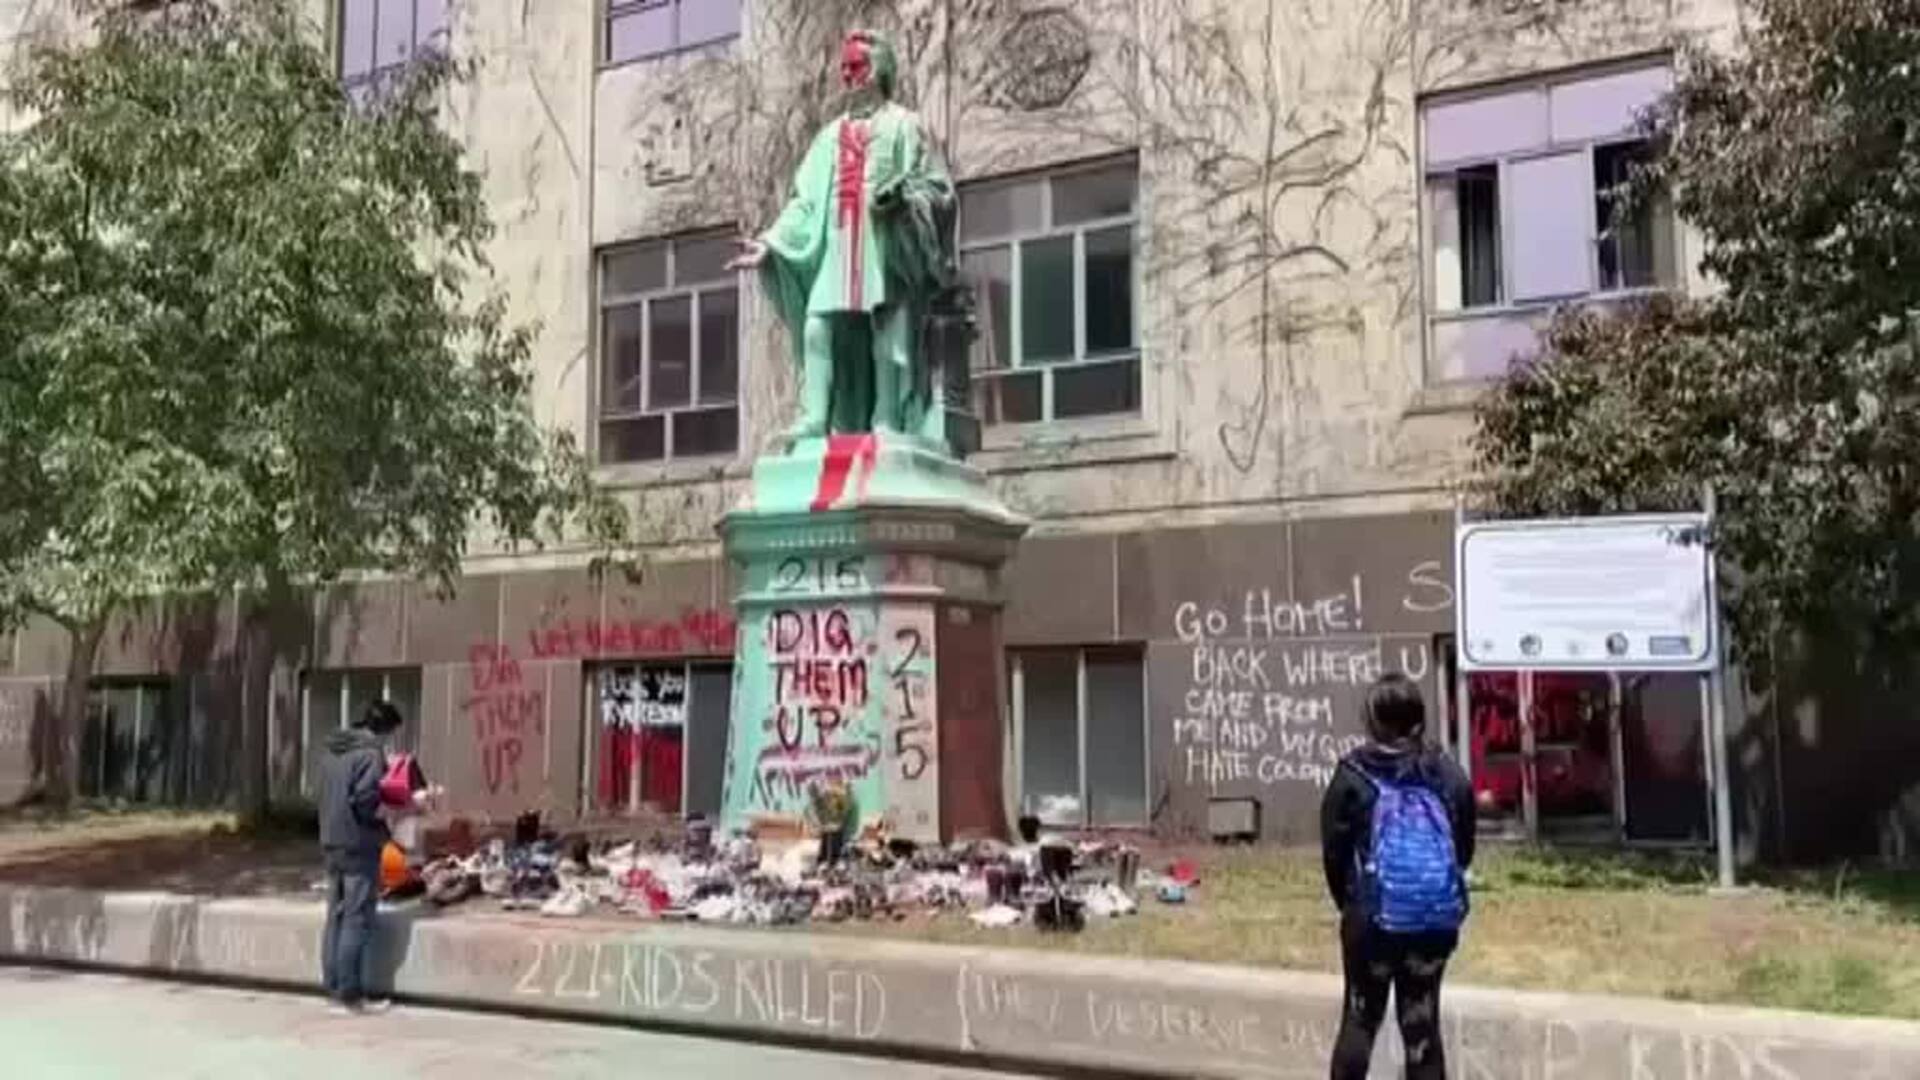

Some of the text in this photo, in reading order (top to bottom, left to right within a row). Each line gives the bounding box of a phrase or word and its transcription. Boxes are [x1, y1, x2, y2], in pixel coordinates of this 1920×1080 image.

[776, 556, 866, 591] 215
[1243, 573, 1362, 640] HOME!
[768, 608, 854, 654] DIG
[769, 658, 868, 706] THEM
[1194, 645, 1271, 690] BACK
[1401, 644, 1428, 681] U
[776, 704, 840, 752] UP
[1185, 689, 1333, 727] CAME FROM
[1186, 746, 1250, 786] HATE
[620, 943, 720, 1013] KIDS
[734, 956, 886, 1038] KILLED
